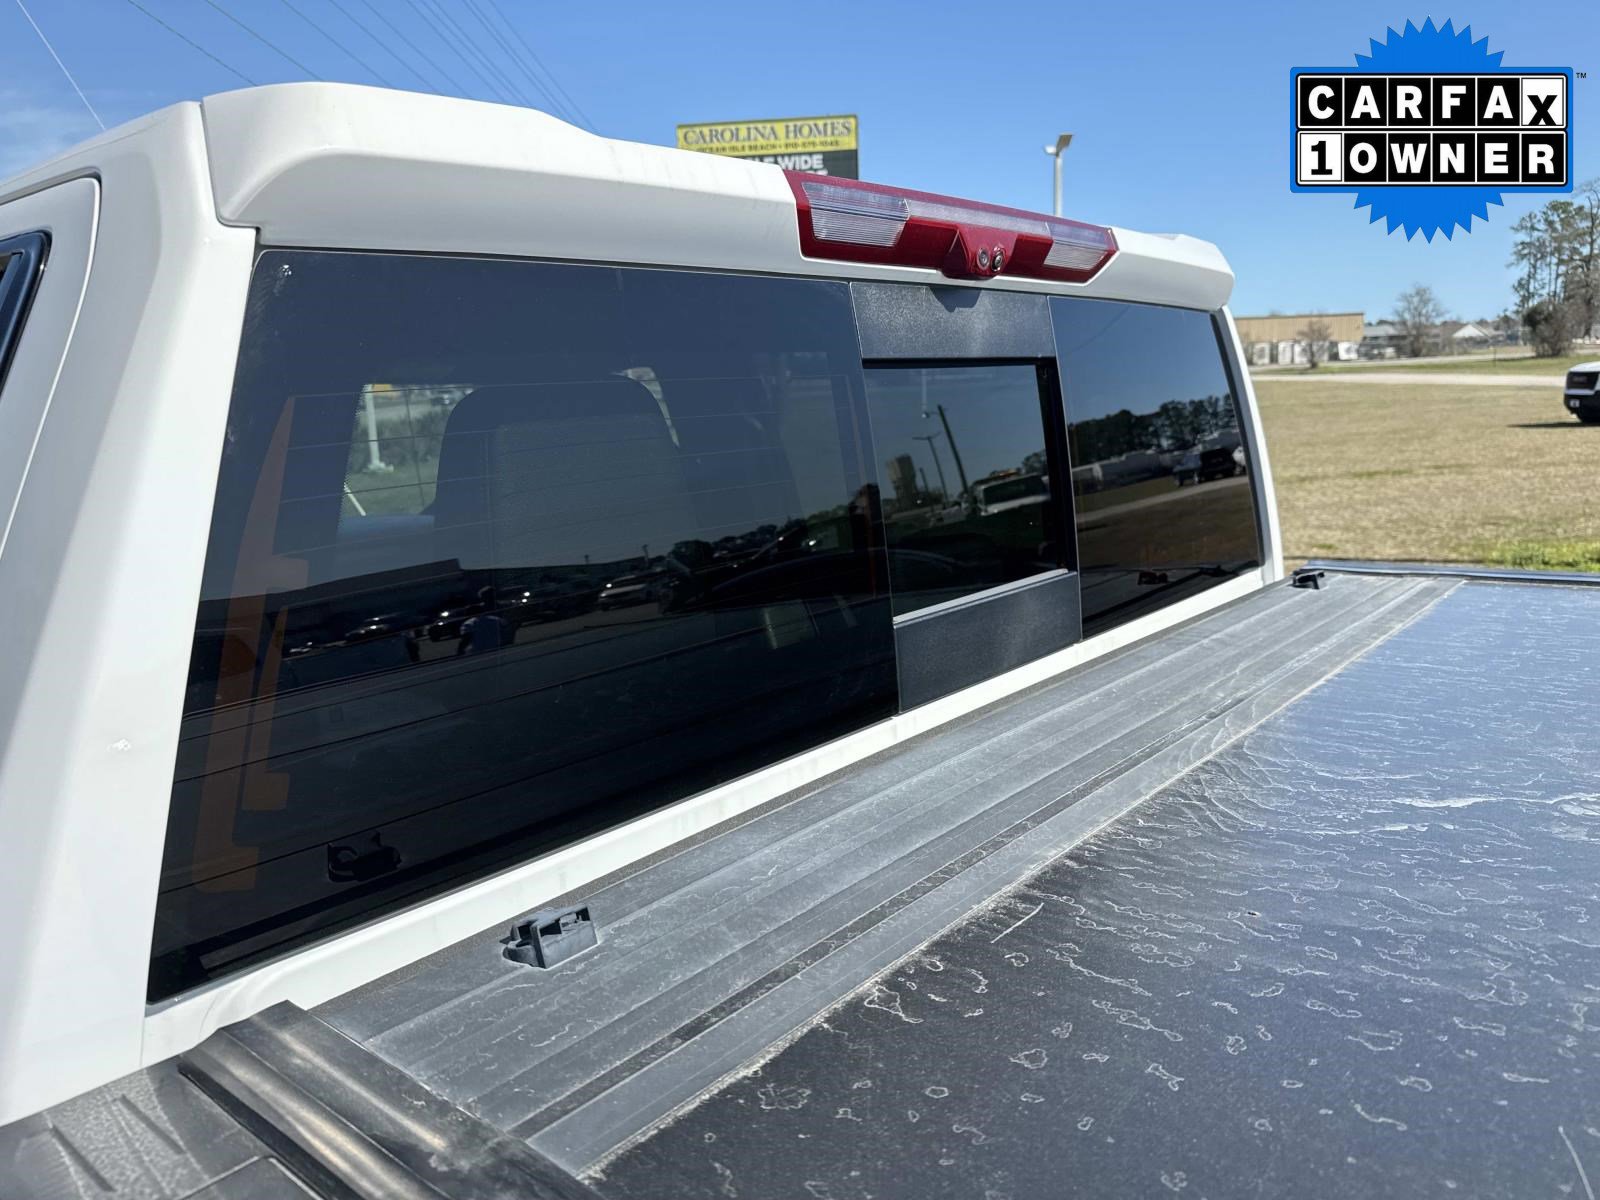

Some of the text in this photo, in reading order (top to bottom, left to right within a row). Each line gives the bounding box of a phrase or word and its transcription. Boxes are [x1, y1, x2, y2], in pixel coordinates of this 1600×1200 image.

[683, 119, 852, 145] CAROLINA HOMES
[776, 153, 824, 170] WIDE
